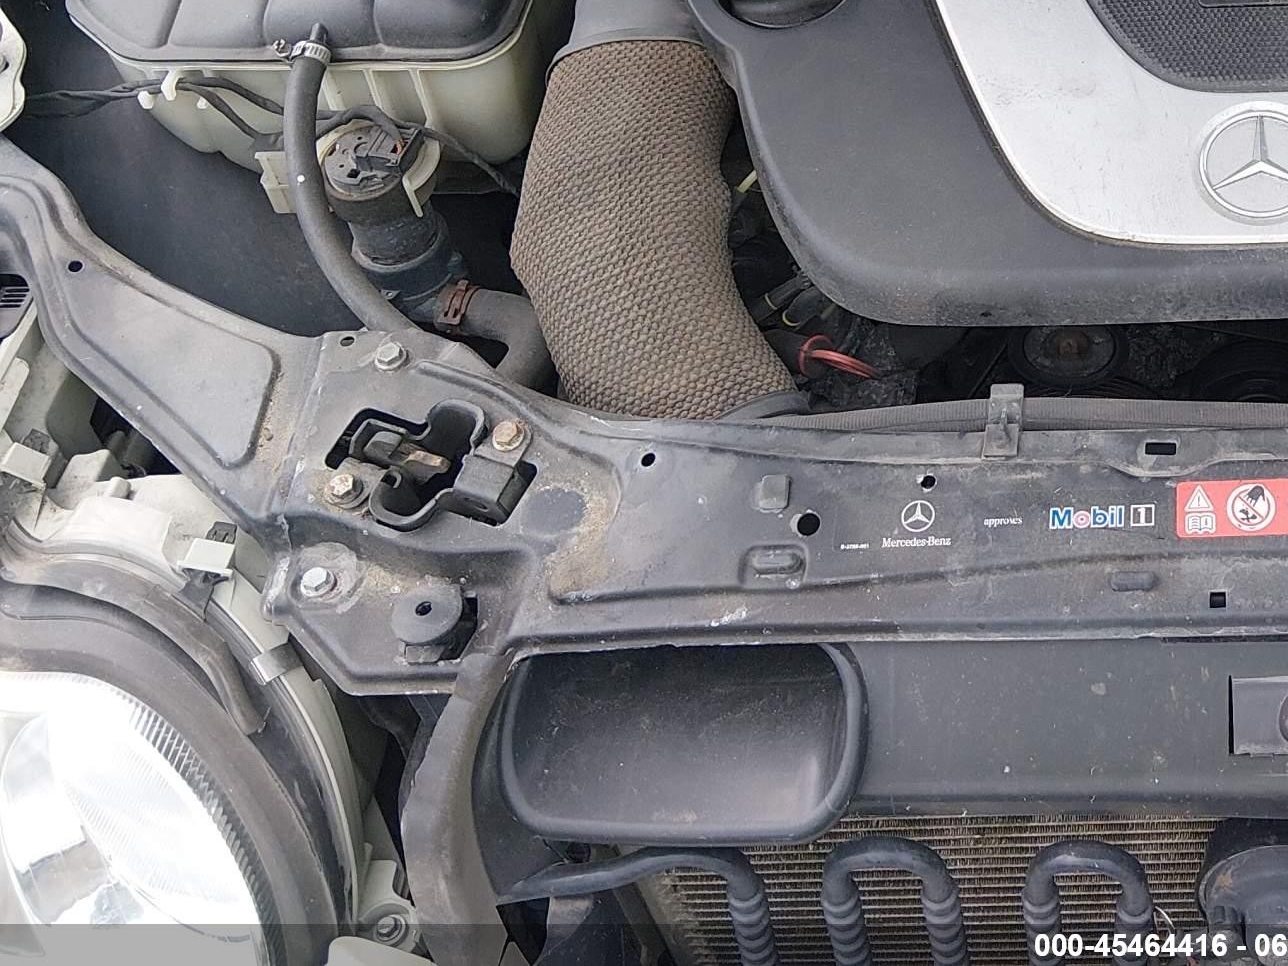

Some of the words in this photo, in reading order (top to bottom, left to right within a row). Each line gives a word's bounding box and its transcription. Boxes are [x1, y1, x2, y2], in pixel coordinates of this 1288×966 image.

[983, 516, 1022, 527] approves
[1049, 506, 1125, 530] Mobil
[881, 536, 951, 549] Mercedes-Benz
